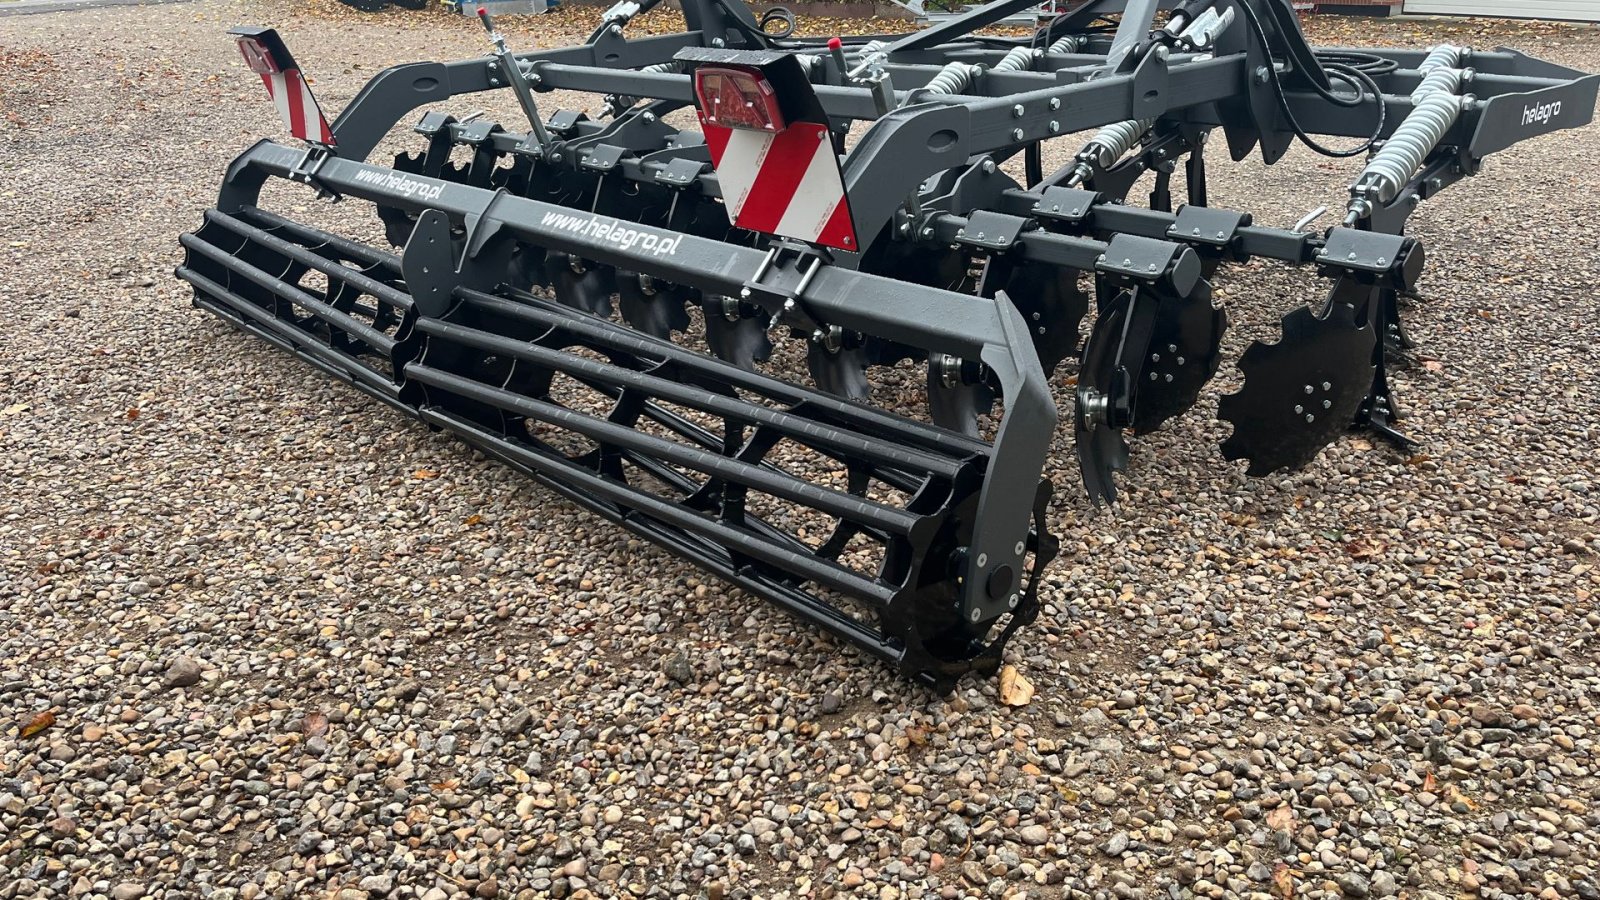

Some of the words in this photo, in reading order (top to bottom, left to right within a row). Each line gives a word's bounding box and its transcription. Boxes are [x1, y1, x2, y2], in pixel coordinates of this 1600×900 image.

[1521, 101, 1561, 126] helagro
[355, 169, 446, 200] www.helagro.pl
[541, 211, 683, 256] www.helagro.pl
